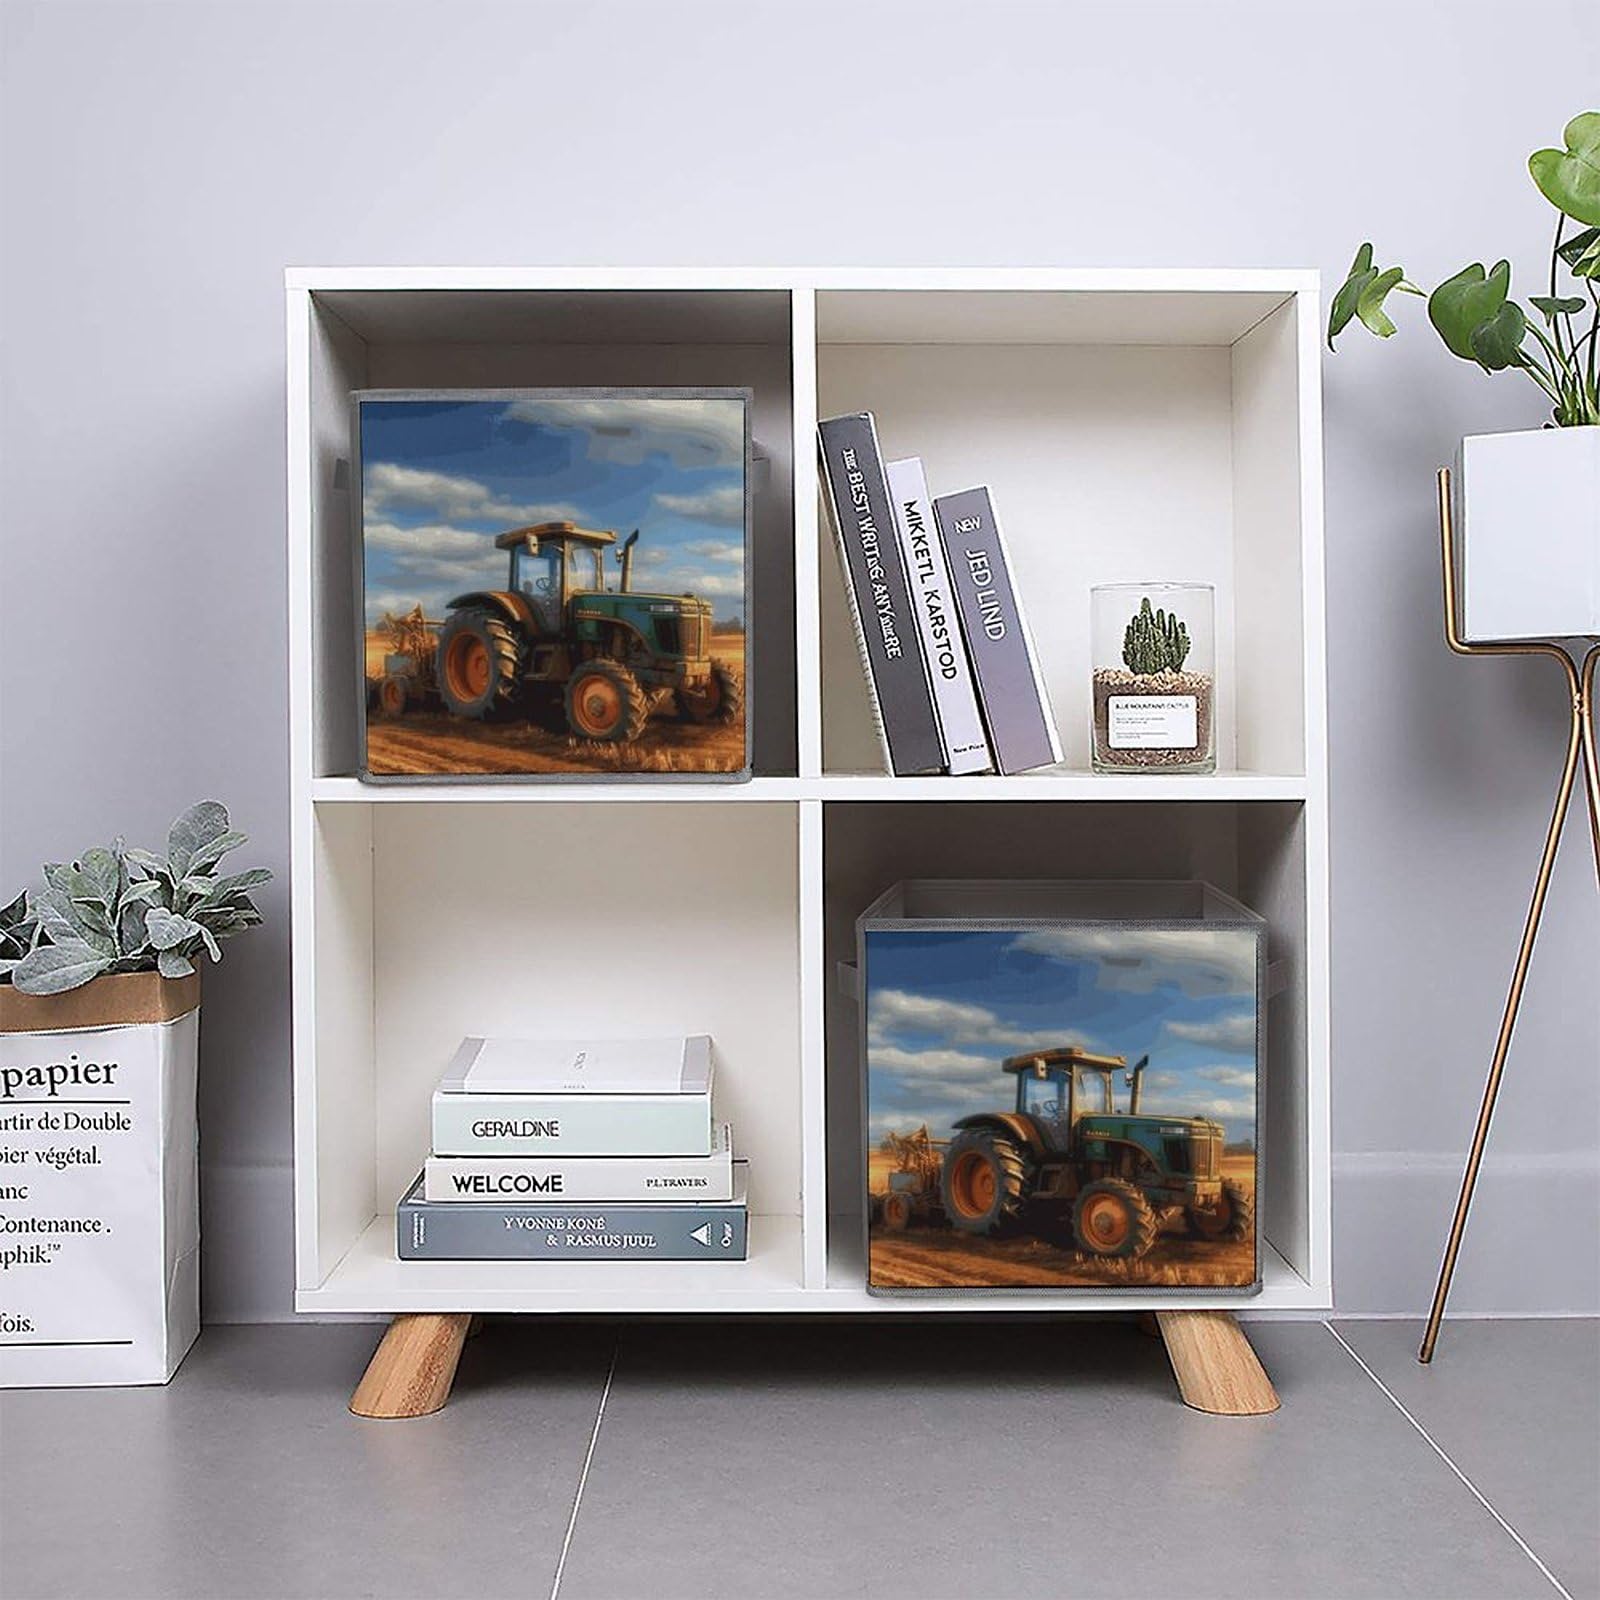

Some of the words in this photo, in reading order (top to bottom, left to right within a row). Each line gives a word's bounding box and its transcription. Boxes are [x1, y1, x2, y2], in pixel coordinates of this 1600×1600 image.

[848, 471, 871, 513] BEST
[954, 516, 982, 534] NEW
[965, 549, 992, 587] JED
[903, 500, 935, 584] MIKKETL
[923, 589, 957, 680] KARSTOD
[977, 589, 1006, 641] LIND
[0, 1055, 118, 1098] papier
[37, 1112, 60, 1130] de
[64, 1111, 131, 1131] Double
[472, 1121, 559, 1137] GERALDINE
[35, 1146, 101, 1170] végétal.
[452, 1175, 563, 1193] WELCOME
[546, 1235, 558, 1246] &
[566, 1235, 621, 1247] RASMUS
[622, 1235, 657, 1248] JUUL
